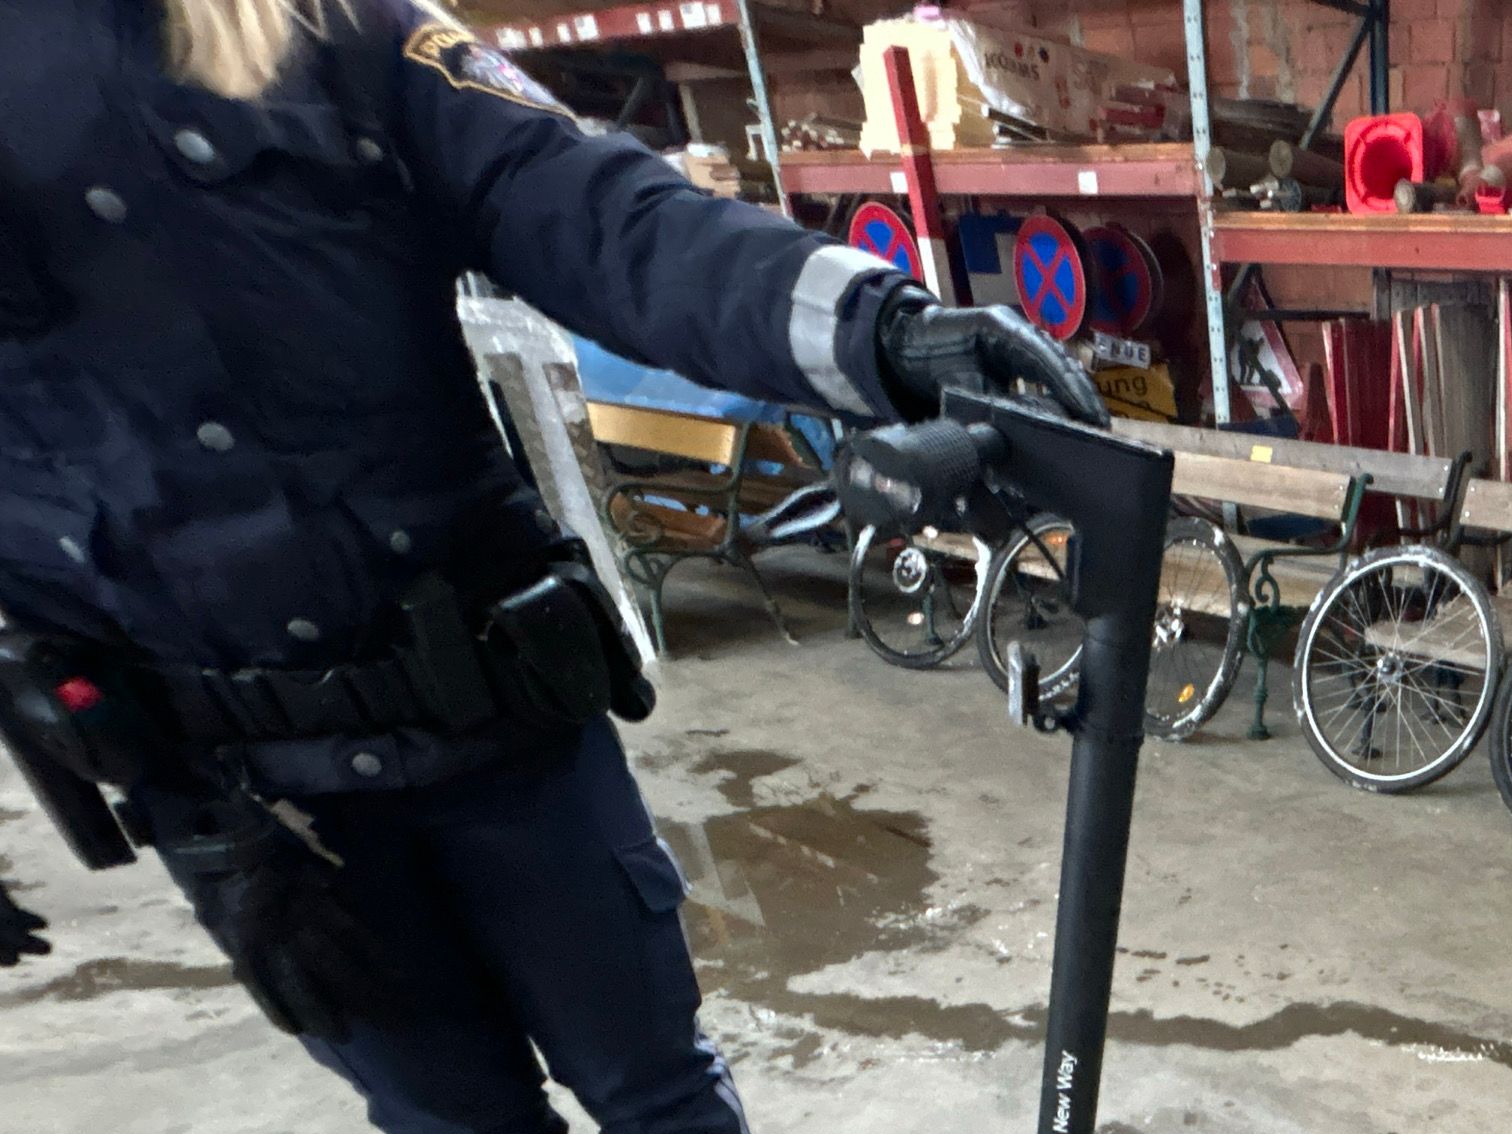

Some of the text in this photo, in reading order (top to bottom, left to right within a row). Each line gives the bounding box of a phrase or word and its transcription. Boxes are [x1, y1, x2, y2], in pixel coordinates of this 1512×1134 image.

[1098, 375, 1149, 397] ung
[1056, 1050, 1078, 1091] Way
[1052, 1092, 1072, 1134] New
